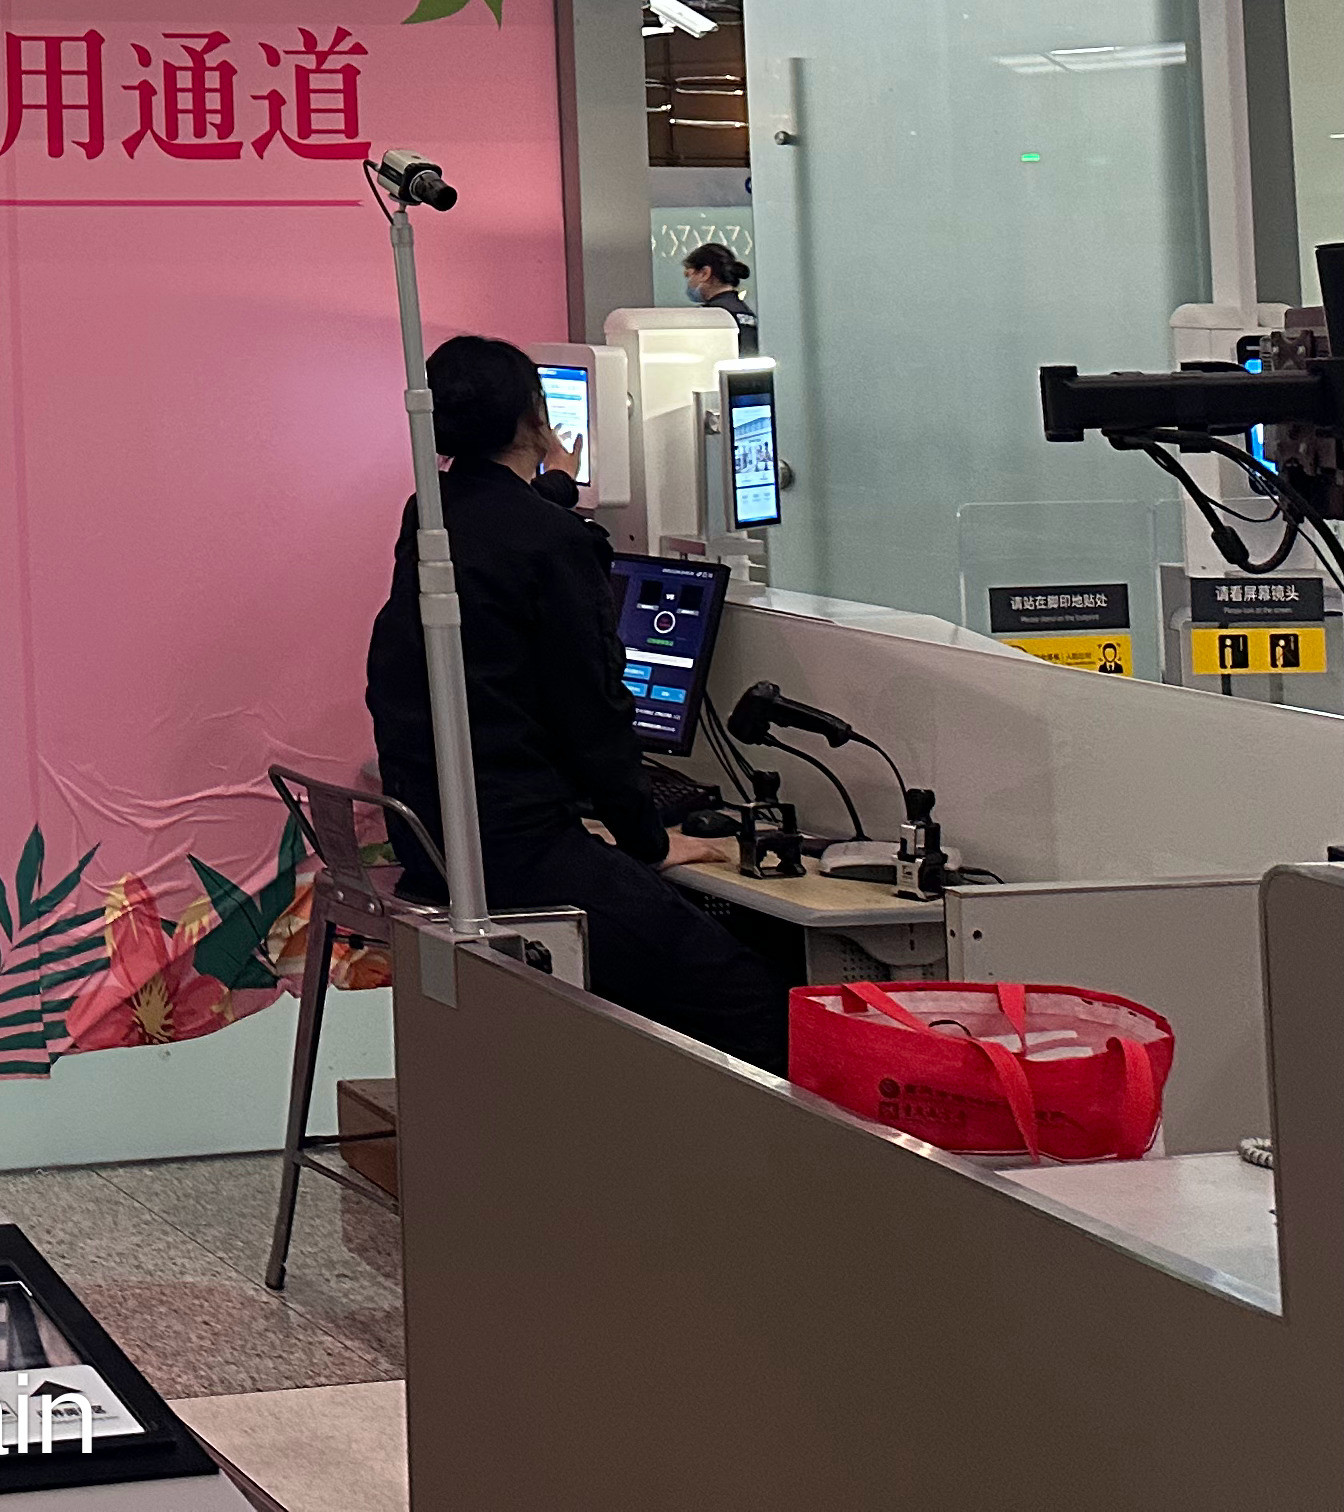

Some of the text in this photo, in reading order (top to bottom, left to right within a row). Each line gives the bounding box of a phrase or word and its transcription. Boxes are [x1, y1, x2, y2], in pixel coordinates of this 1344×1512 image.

[1215, 584, 1299, 602] 请看屏幕镜头
